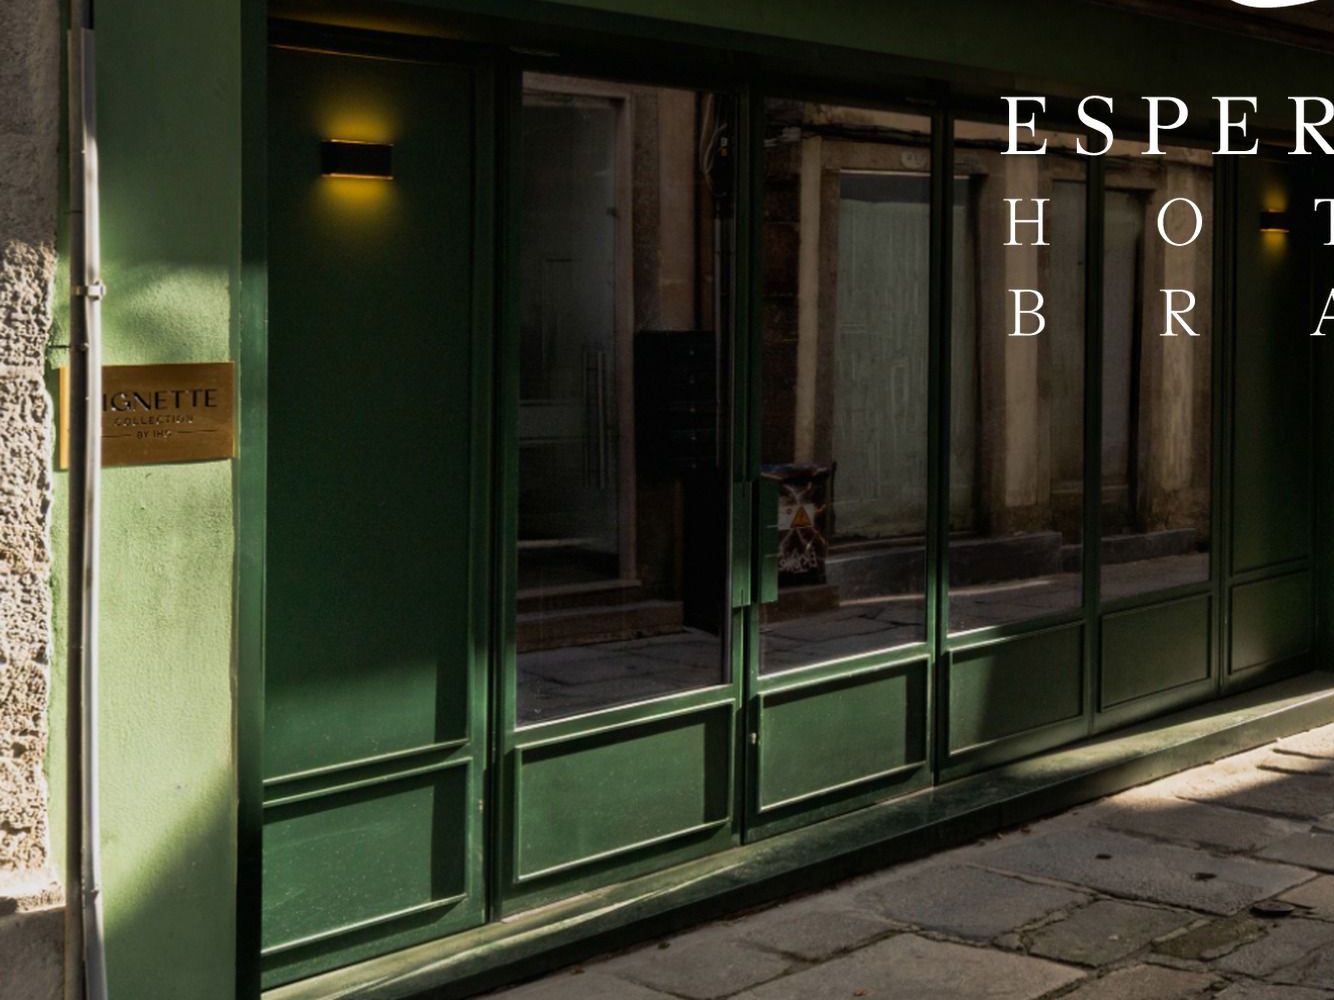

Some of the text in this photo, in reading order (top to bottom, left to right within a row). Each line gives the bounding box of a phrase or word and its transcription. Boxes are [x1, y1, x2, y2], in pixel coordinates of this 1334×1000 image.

[102, 388, 217, 412] IGNETTE
[114, 415, 194, 427] COLLECTION
[137, 430, 149, 440] BY
